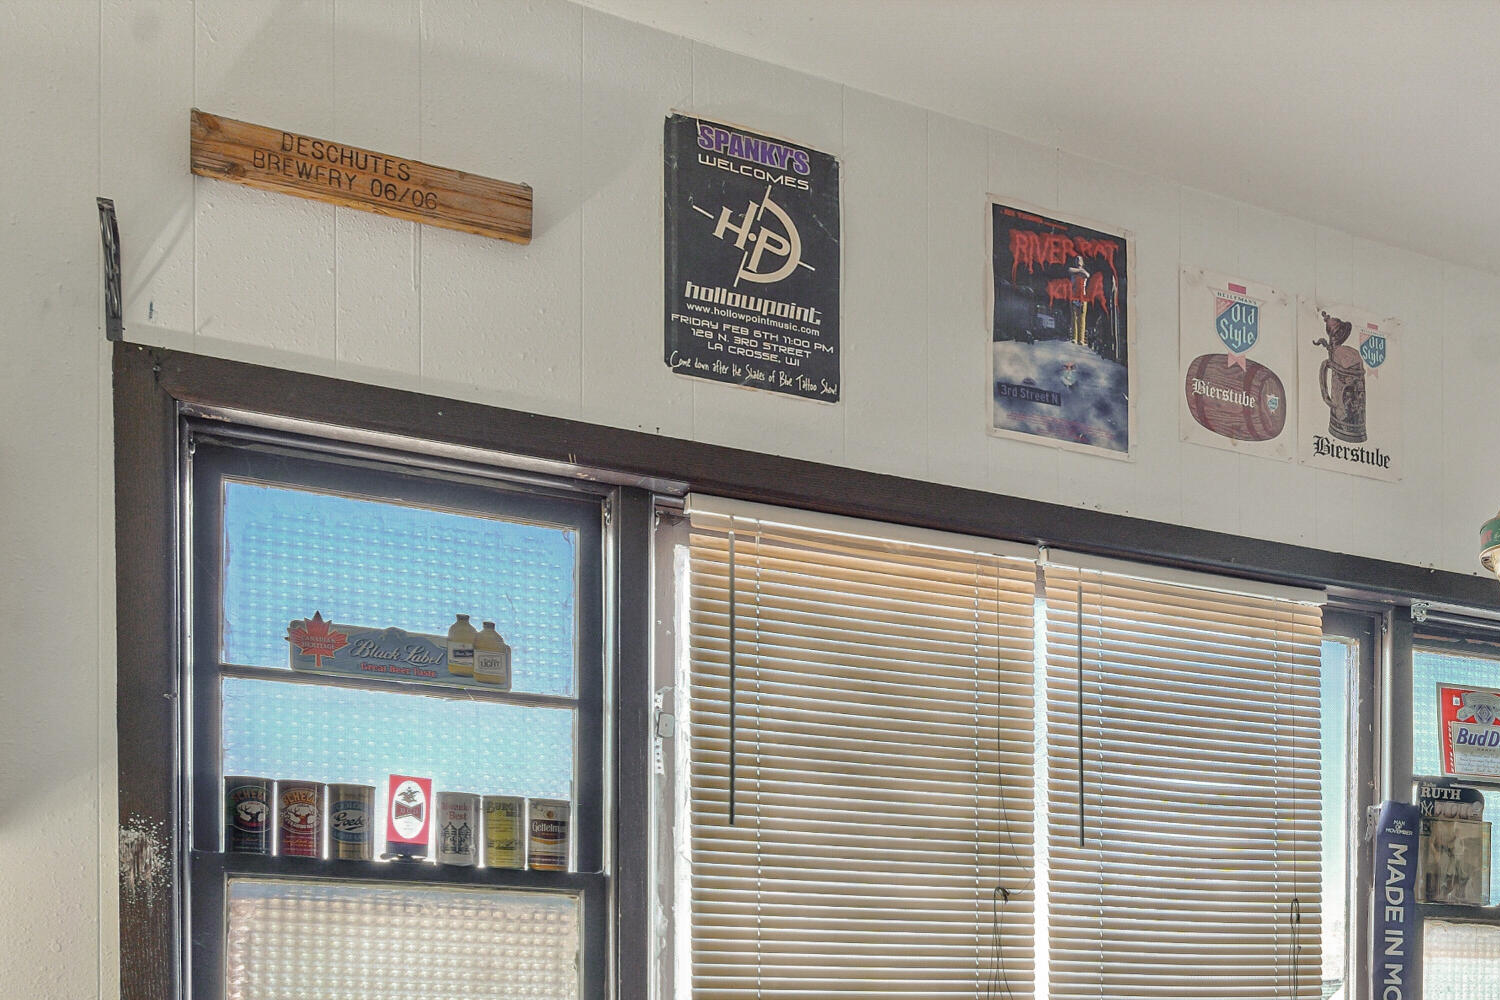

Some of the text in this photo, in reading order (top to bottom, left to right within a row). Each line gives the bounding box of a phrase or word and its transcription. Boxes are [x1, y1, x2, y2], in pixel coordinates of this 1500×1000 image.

[281, 132, 411, 182] DESCHUTES
[697, 123, 811, 176] SPANKY'S
[698, 153, 809, 190] WELCOMES
[370, 178, 438, 210] 06/06
[686, 302, 820, 337] www.hollowpointmusic.com
[1231, 303, 1255, 325] Old
[671, 313, 718, 330] FRIDAY
[722, 323, 749, 336] FEB
[782, 335, 811, 349] 11:00
[814, 342, 834, 354] PM
[691, 328, 714, 339] 128
[733, 336, 758, 348] 3RD
[762, 341, 811, 358] STREET
[1219, 318, 1255, 349] Style
[1369, 335, 1384, 350] Old
[707, 341, 724, 352] LA
[785, 356, 800, 367] WI
[1362, 346, 1384, 364] Style
[1000, 384, 1018, 398] 3rd
[1020, 387, 1049, 403] Street
[1191, 377, 1256, 409] Bierstube
[1312, 434, 1391, 469] Bierstube
[350, 638, 443, 667] Black Label
[1456, 727, 1488, 746] Bud
[1420, 786, 1461, 800] RUTH
[1385, 842, 1409, 924] MADE
[1384, 929, 1404, 957] IN
